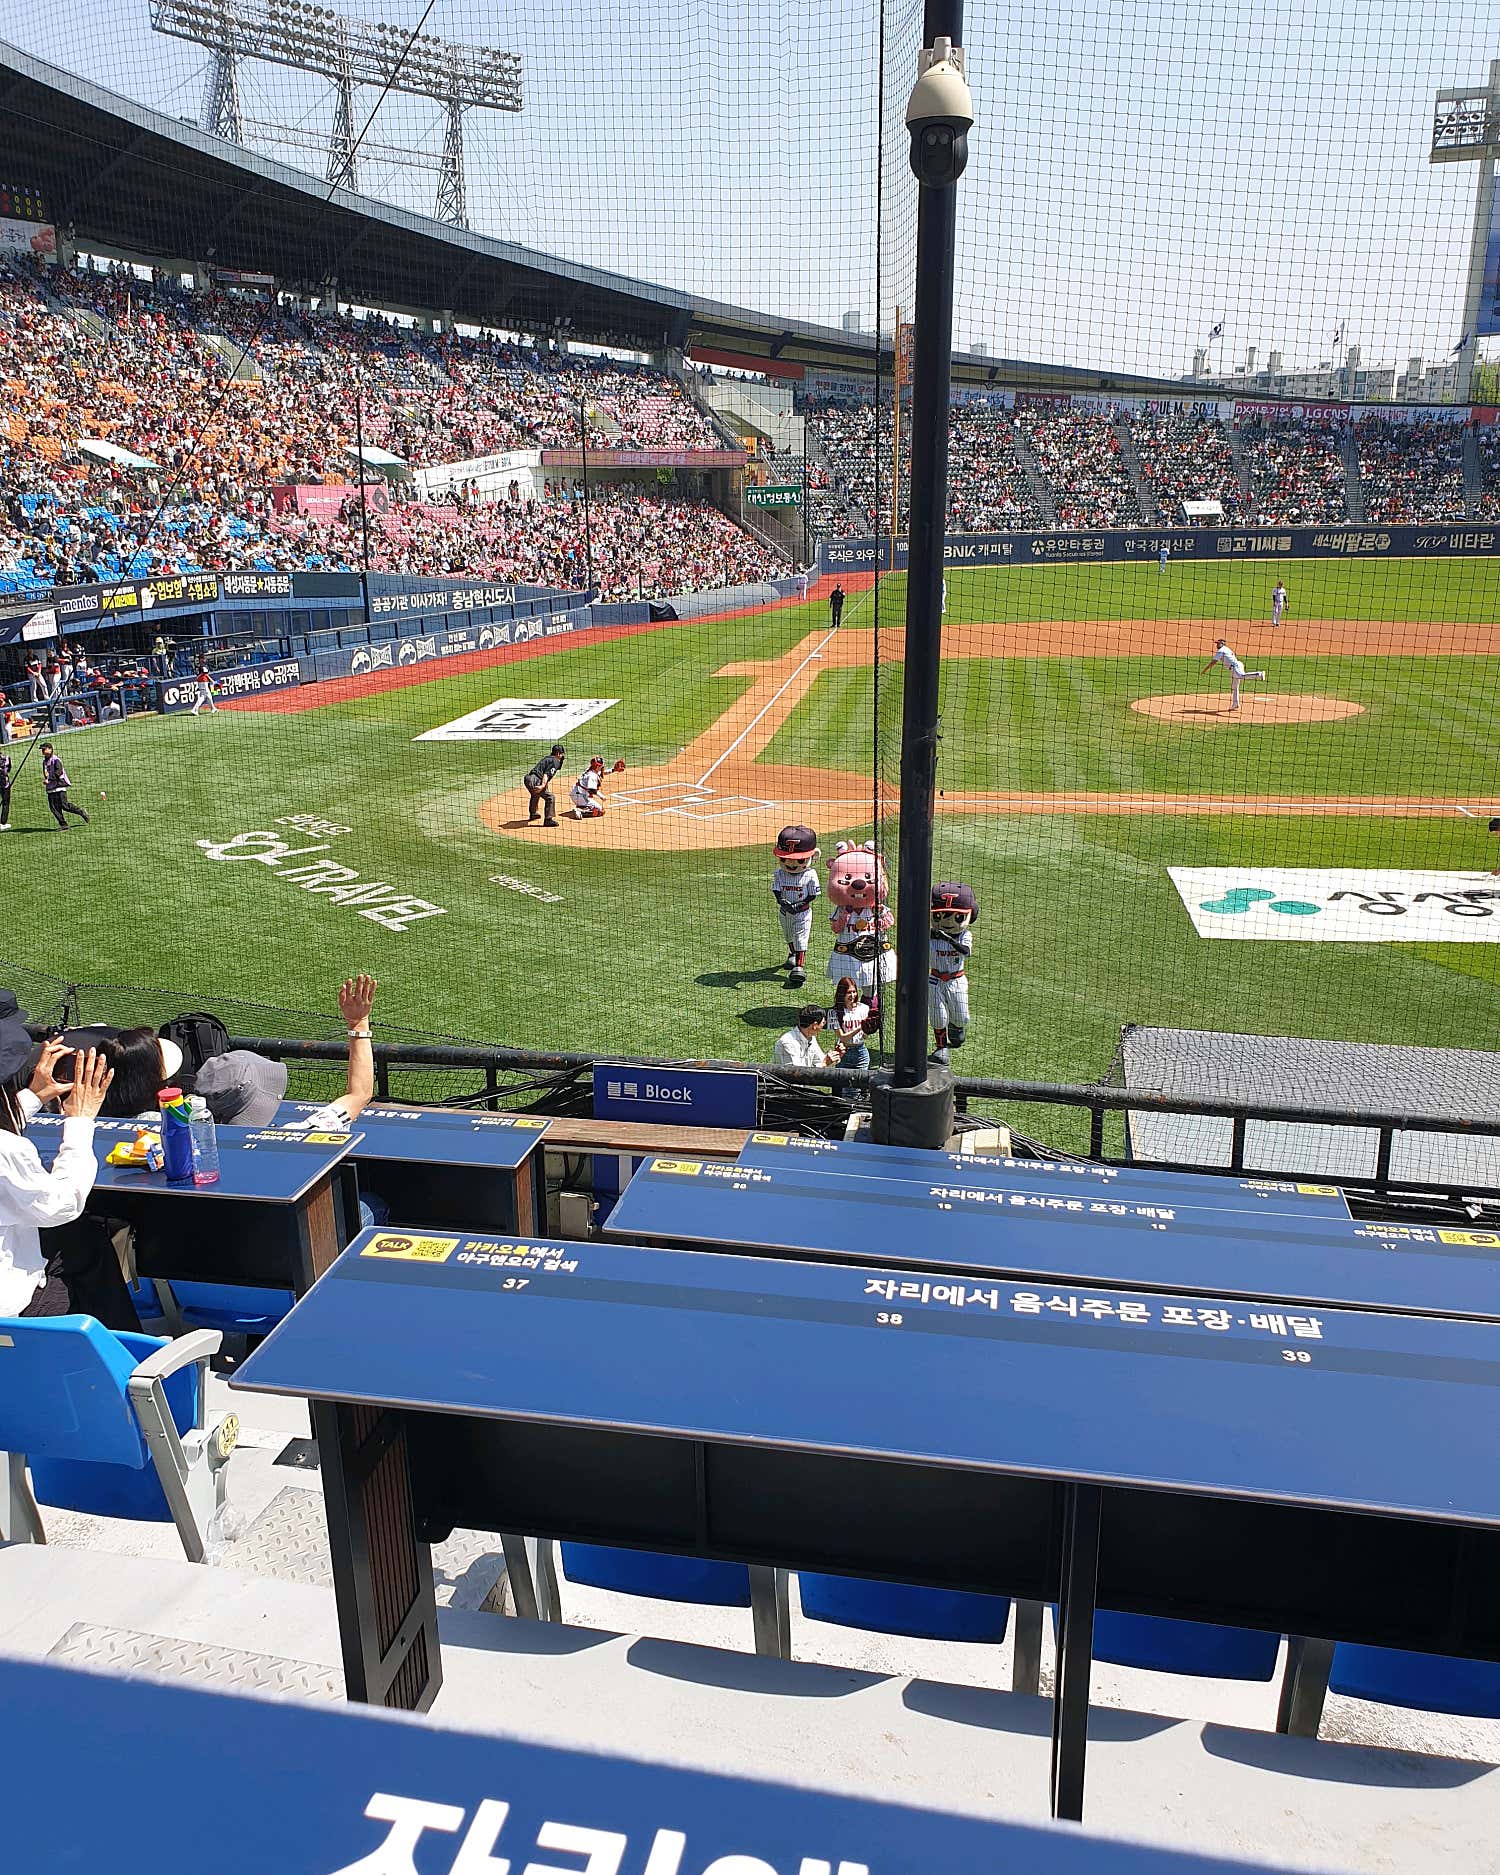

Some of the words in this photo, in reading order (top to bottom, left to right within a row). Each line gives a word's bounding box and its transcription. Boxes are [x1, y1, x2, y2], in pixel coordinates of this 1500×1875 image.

[1045, 538, 1105, 551] 유안타증권
[1125, 538, 1195, 552] 한국경제신문
[1450, 533, 1496, 550] 비타란
[828, 550, 854, 563] 주식은
[944, 546, 976, 558] BNK
[978, 543, 1014, 556] 캐피탈
[148, 580, 183, 601] 수협보험
[61, 595, 98, 613] mentos
[372, 596, 409, 613] 공공기관
[410, 592, 448, 609] 이사가자!
[451, 587, 516, 610] 충남혁신도시
[273, 859, 449, 932] TRAVEL
[940, 893, 959, 907] T
[607, 1082, 637, 1098] 블록
[645, 1084, 692, 1101] Block
[947, 1154, 1000, 1167] 자리에서
[929, 1187, 1003, 1204] 자리에서
[1008, 1194, 1084, 1212] 음식주문
[1089, 1202, 1176, 1220] 포장·배달
[379, 1239, 411, 1251] TALK
[463, 1241, 565, 1259] 카카오톡에서
[456, 1251, 541, 1270] 야구앤오더
[542, 1258, 579, 1273] 검색
[502, 1277, 530, 1290] 37
[863, 1278, 999, 1310] 자리에서
[1009, 1292, 1152, 1324] 음식주문
[1160, 1305, 1325, 1340] 포장·배달
[875, 1312, 904, 1326] 38
[1281, 1349, 1312, 1364] 39
